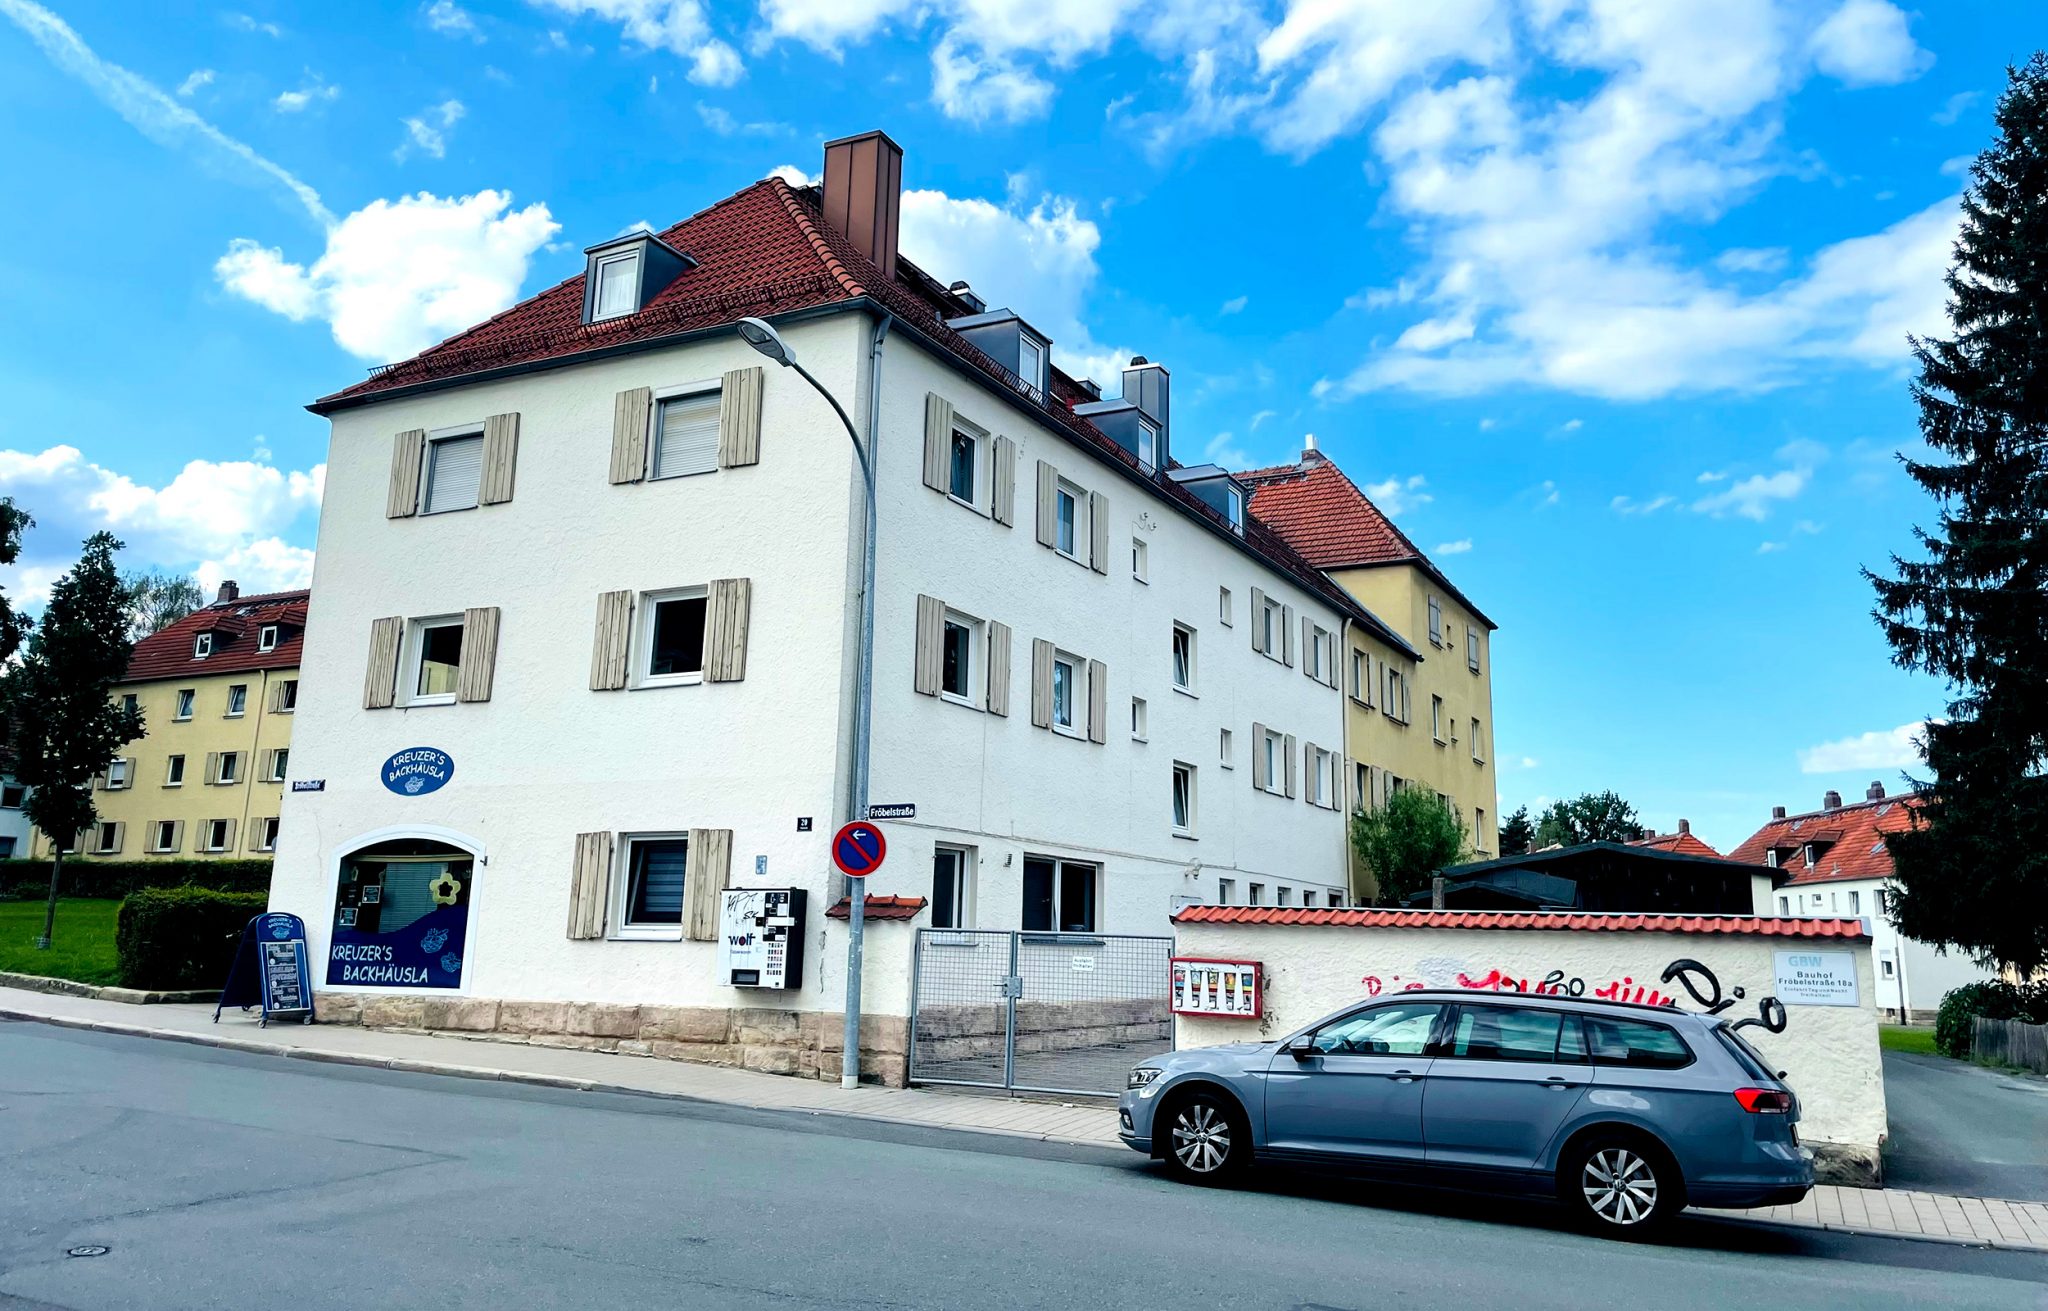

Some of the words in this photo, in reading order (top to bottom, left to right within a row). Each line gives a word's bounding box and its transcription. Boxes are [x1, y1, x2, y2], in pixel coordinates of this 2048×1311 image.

[392, 751, 446, 768] KREUZER'S
[389, 762, 445, 782] BACKHÄUSLA
[870, 806, 914, 817] Fröbelstraße
[728, 933, 756, 946] wolf
[331, 944, 393, 962] KREUZER'S
[1788, 955, 1822, 967] GBW
[343, 963, 428, 984] BACKHÄUSLA
[1796, 970, 1833, 979] Bauhof
[1778, 977, 1836, 986] Fröbelstraße
[1837, 979, 1853, 987] 18a
